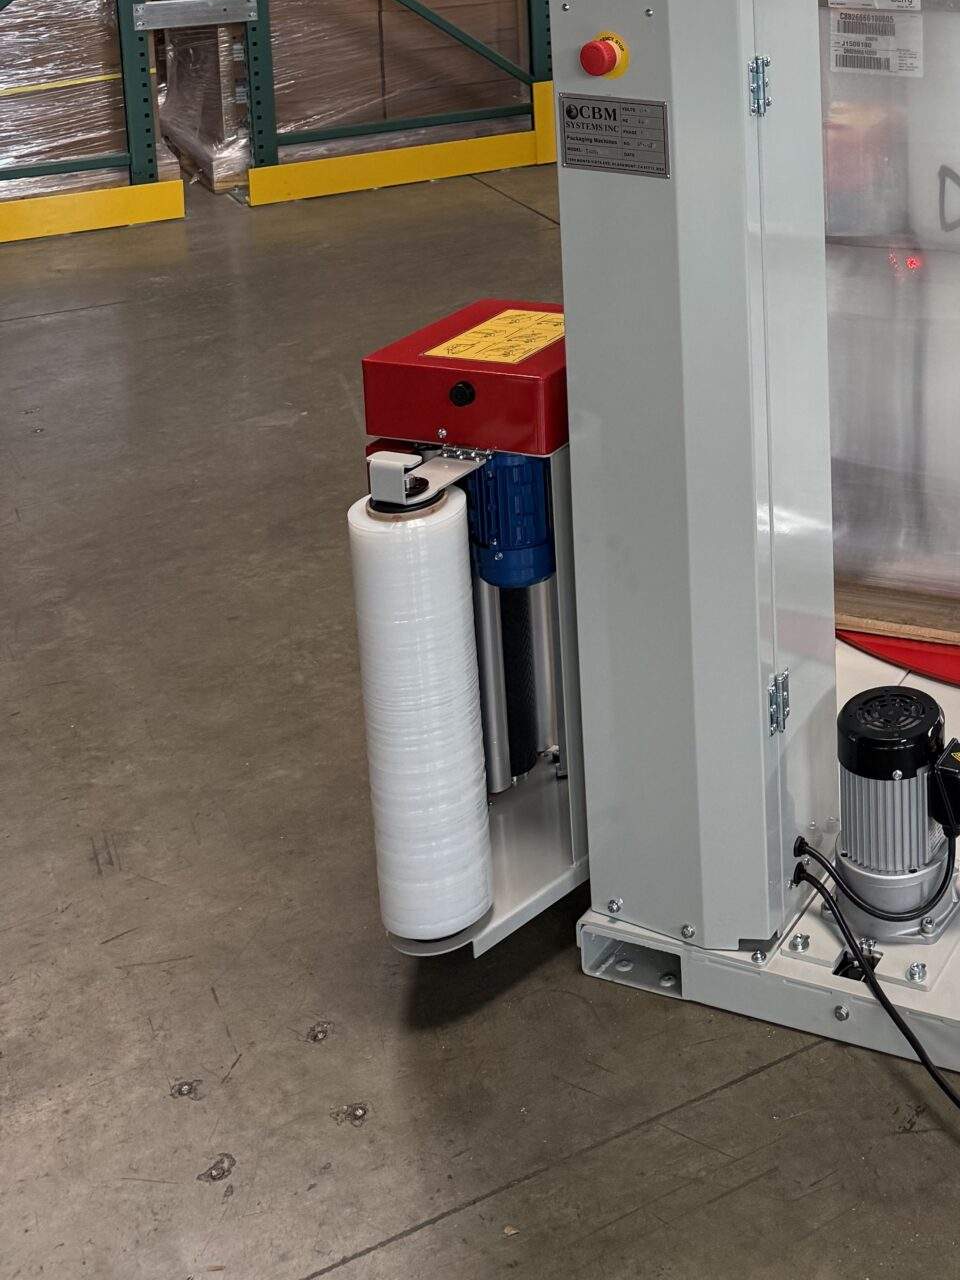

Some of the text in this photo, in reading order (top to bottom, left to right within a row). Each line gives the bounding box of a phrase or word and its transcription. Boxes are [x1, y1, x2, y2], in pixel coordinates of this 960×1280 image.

[579, 105, 617, 121] CBM
[565, 120, 619, 133] SYSTEMS INC
